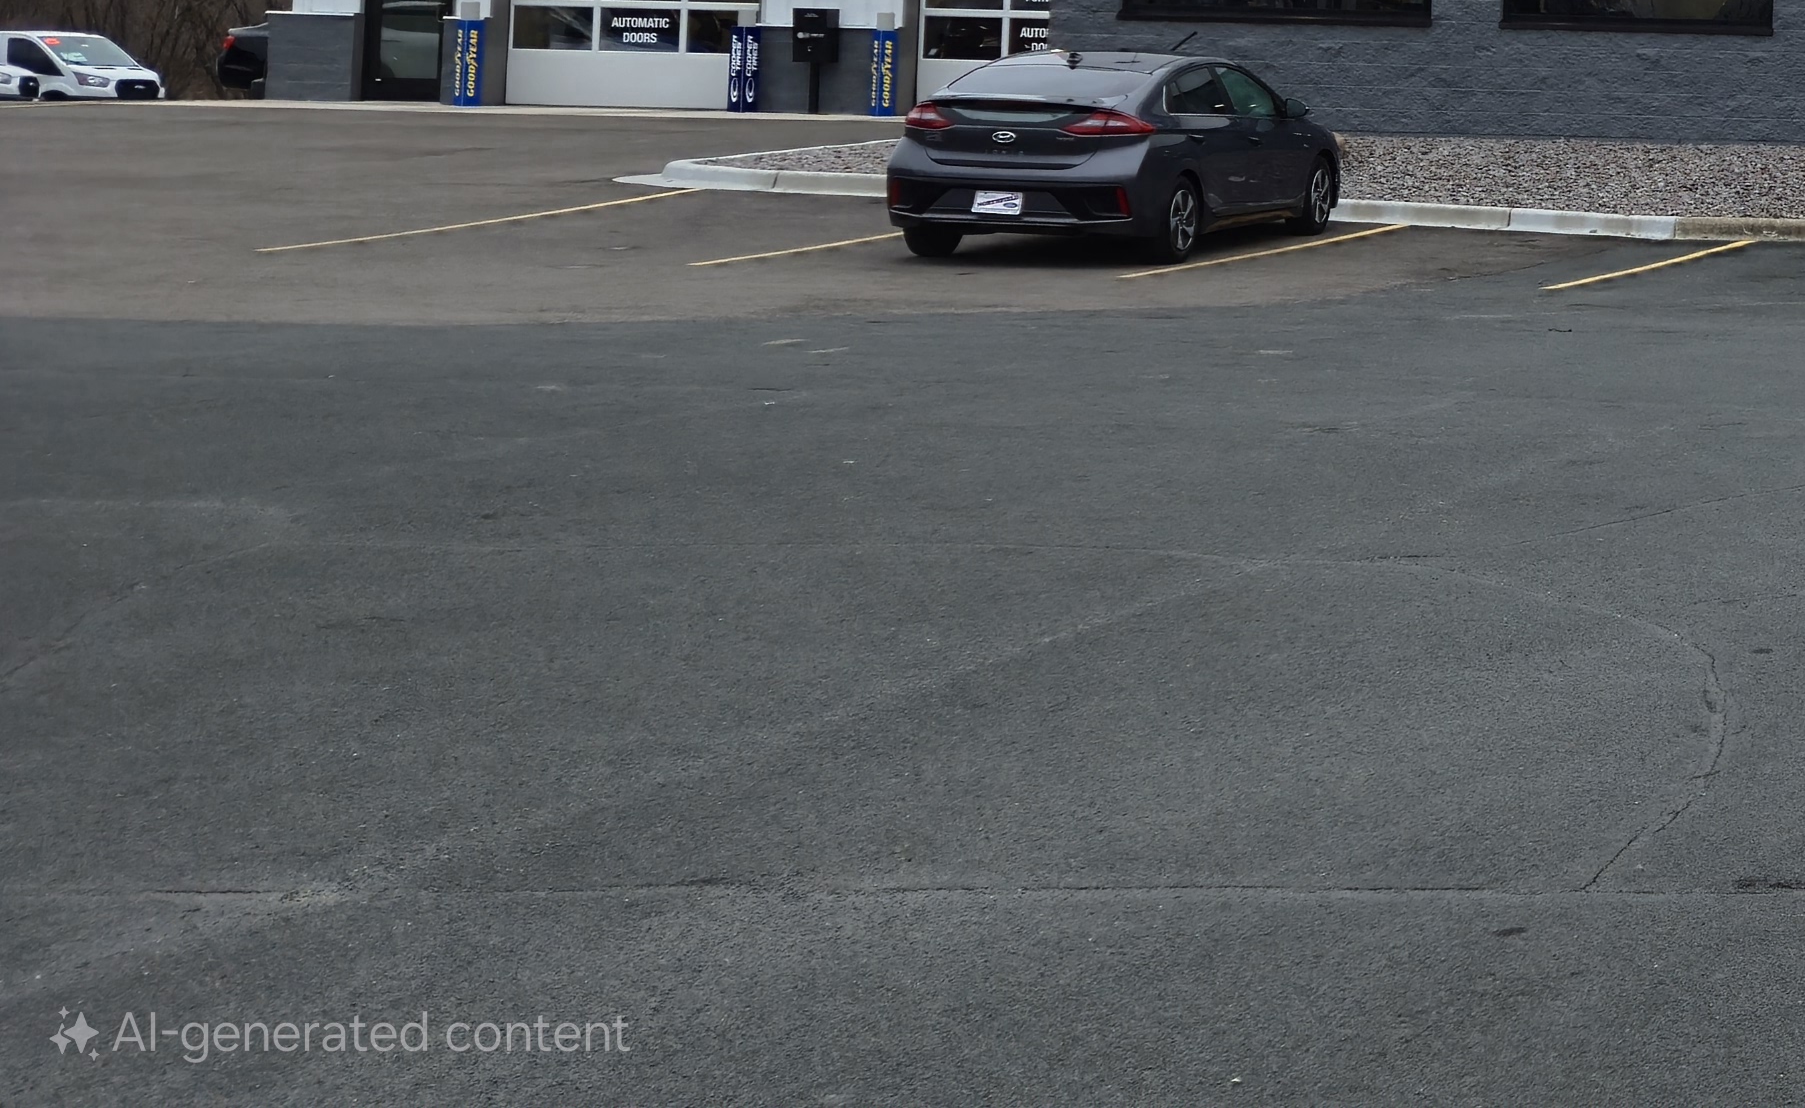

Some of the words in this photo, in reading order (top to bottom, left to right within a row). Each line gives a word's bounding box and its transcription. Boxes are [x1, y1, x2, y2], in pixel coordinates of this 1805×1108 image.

[611, 17, 670, 29] AUTOMATIC
[1020, 27, 1049, 38] AUTO
[622, 32, 657, 44] DOORS
[466, 29, 479, 97] GOODYEAR
[745, 34, 753, 77] COOPER
[881, 40, 893, 108] GOODYEAR
